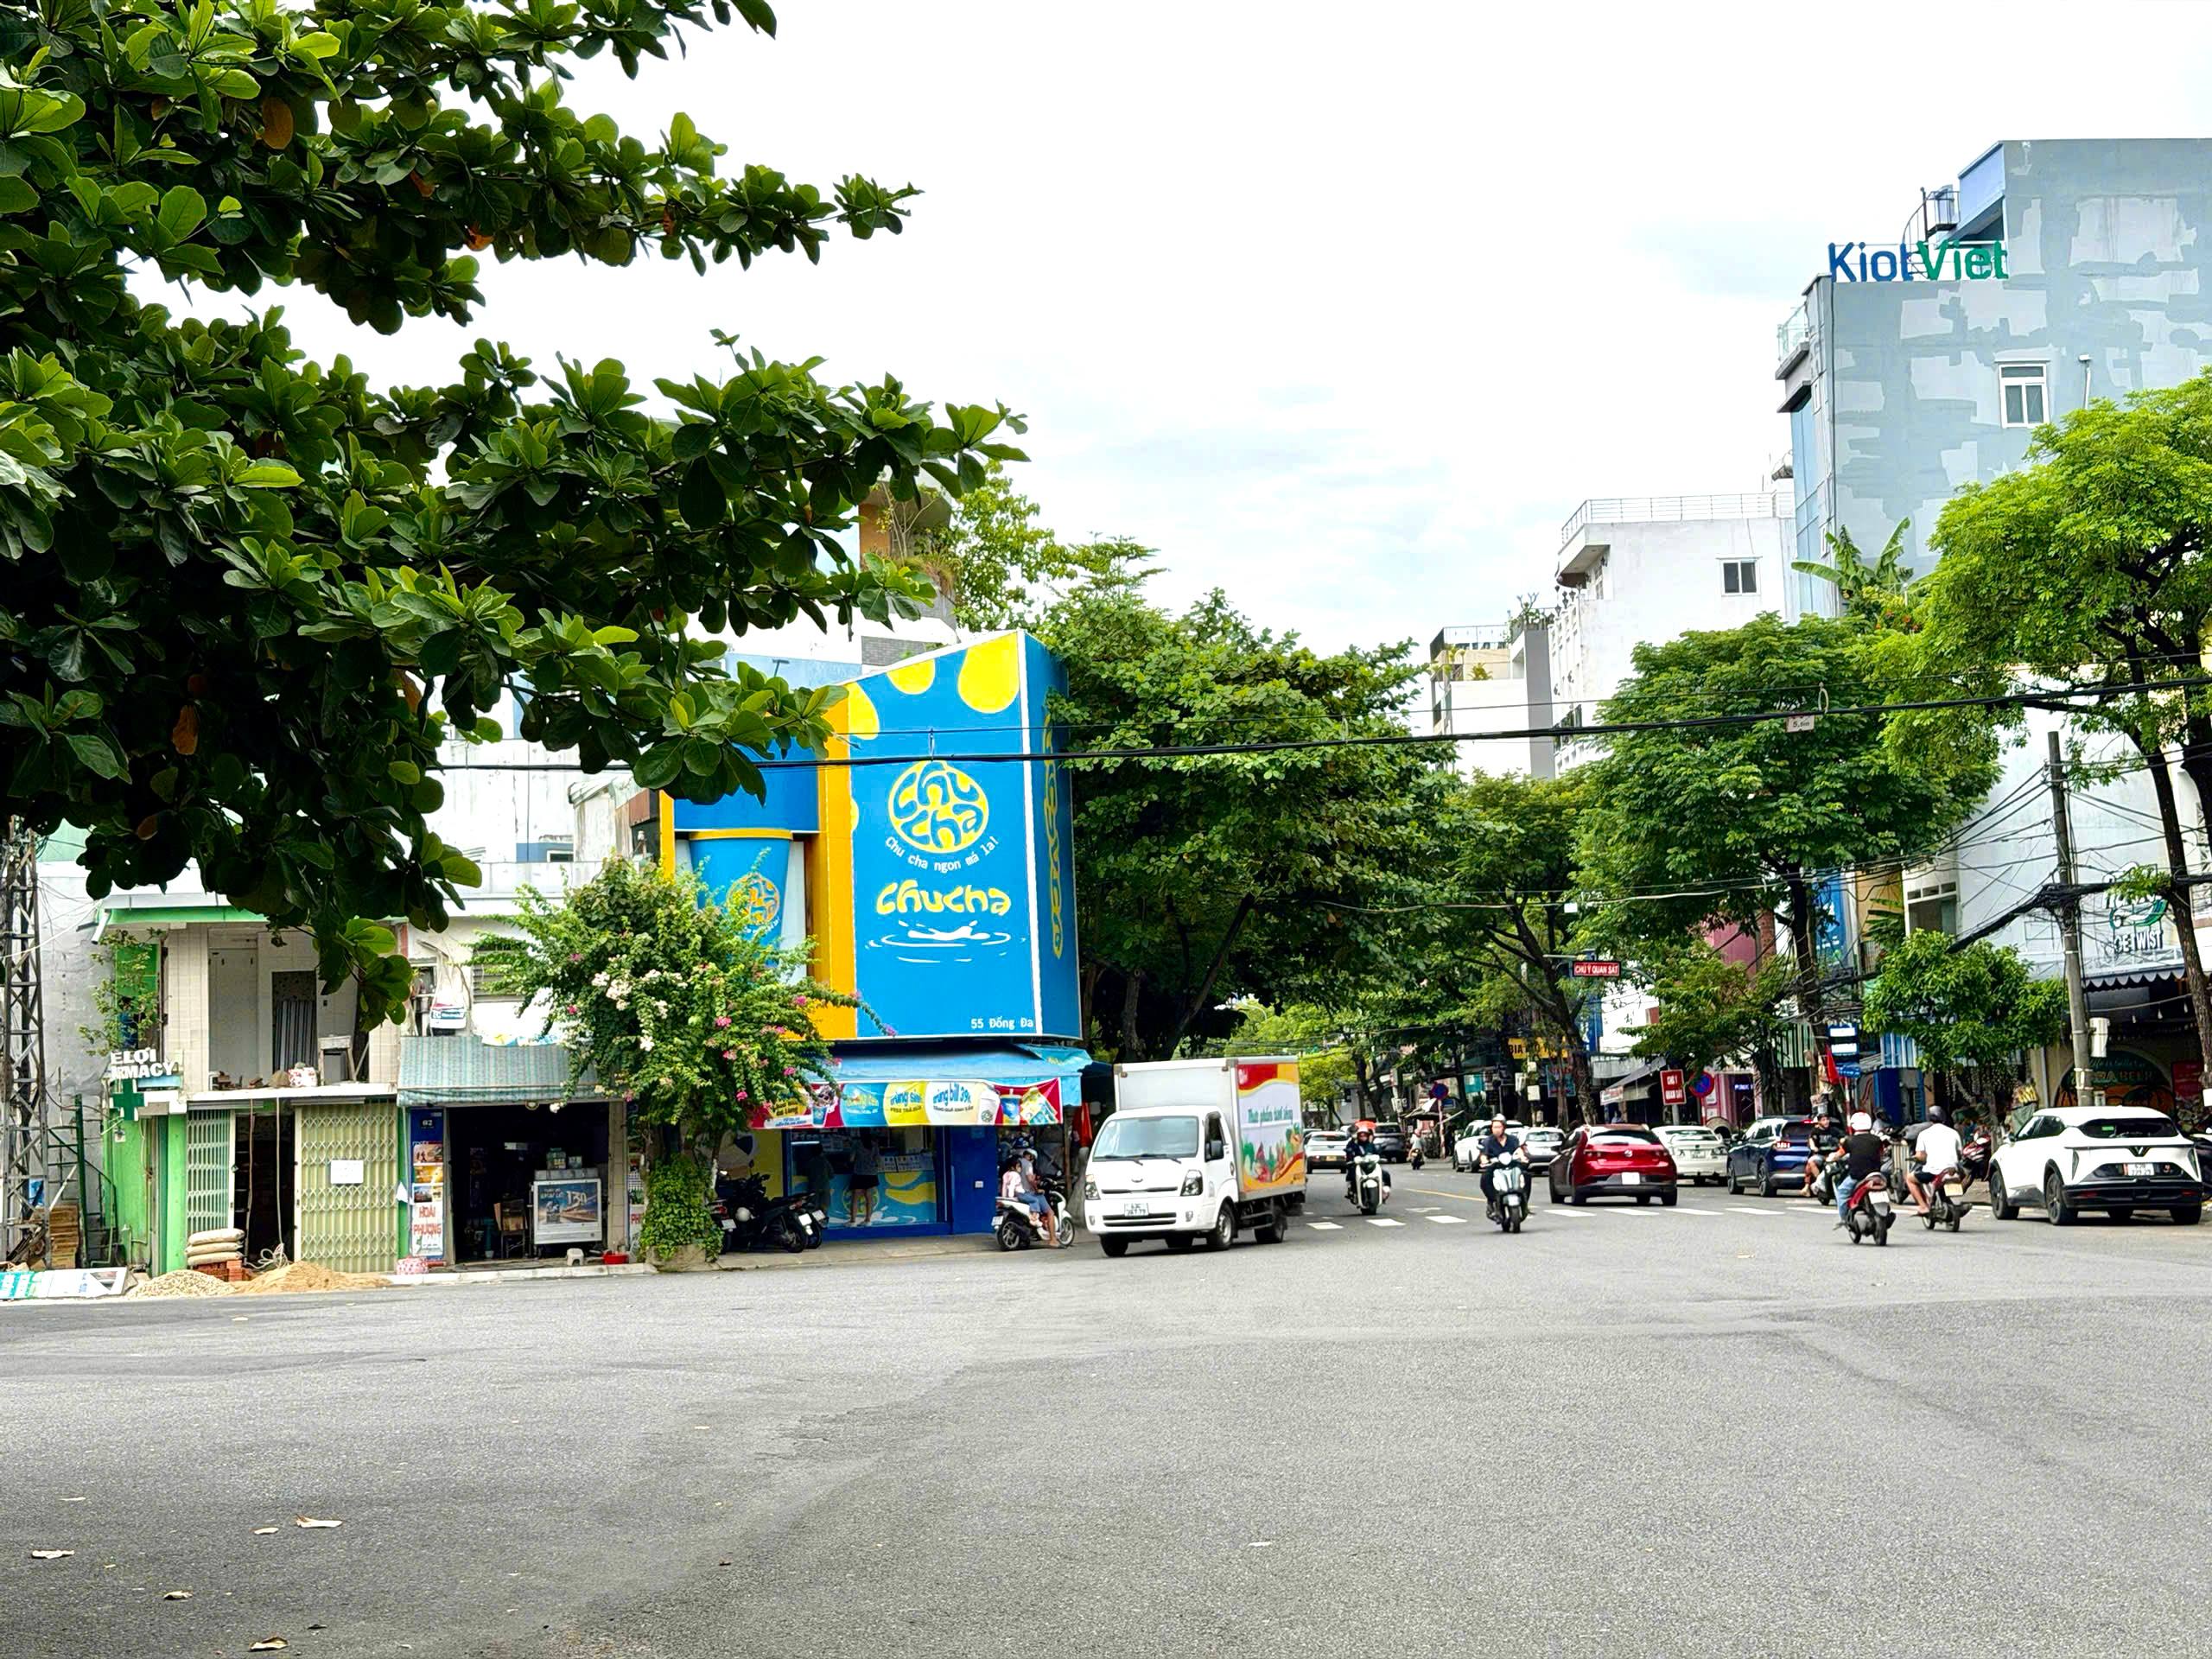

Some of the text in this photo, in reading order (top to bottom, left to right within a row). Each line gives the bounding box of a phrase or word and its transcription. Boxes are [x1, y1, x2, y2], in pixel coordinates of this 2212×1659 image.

[1828, 239, 2009, 283] KiotViet
[886, 836, 906, 858] Chu
[907, 855, 929, 870] cha
[934, 860, 962, 874] ngon
[970, 1018, 984, 1029] 55
[1020, 1017, 1034, 1028] Đa
